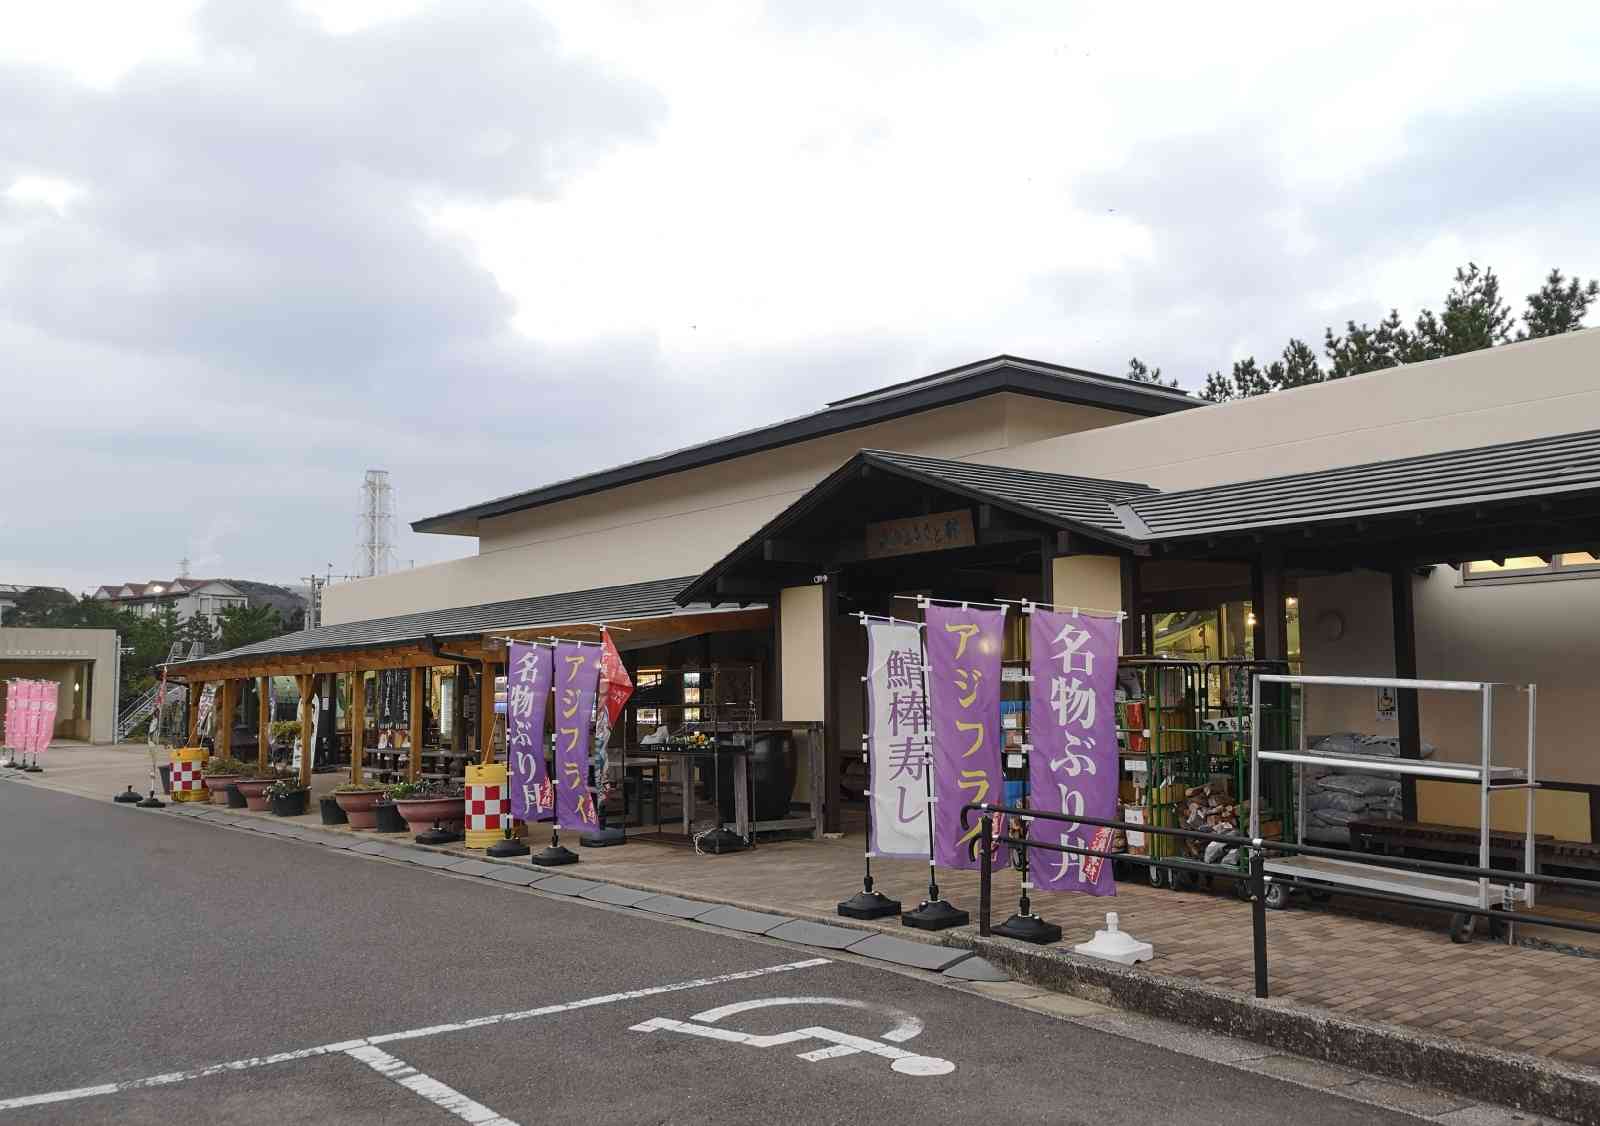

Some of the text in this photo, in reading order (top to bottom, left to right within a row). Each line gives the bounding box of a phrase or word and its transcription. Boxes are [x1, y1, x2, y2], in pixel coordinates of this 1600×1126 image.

[560, 655, 587, 824] アジフライ
